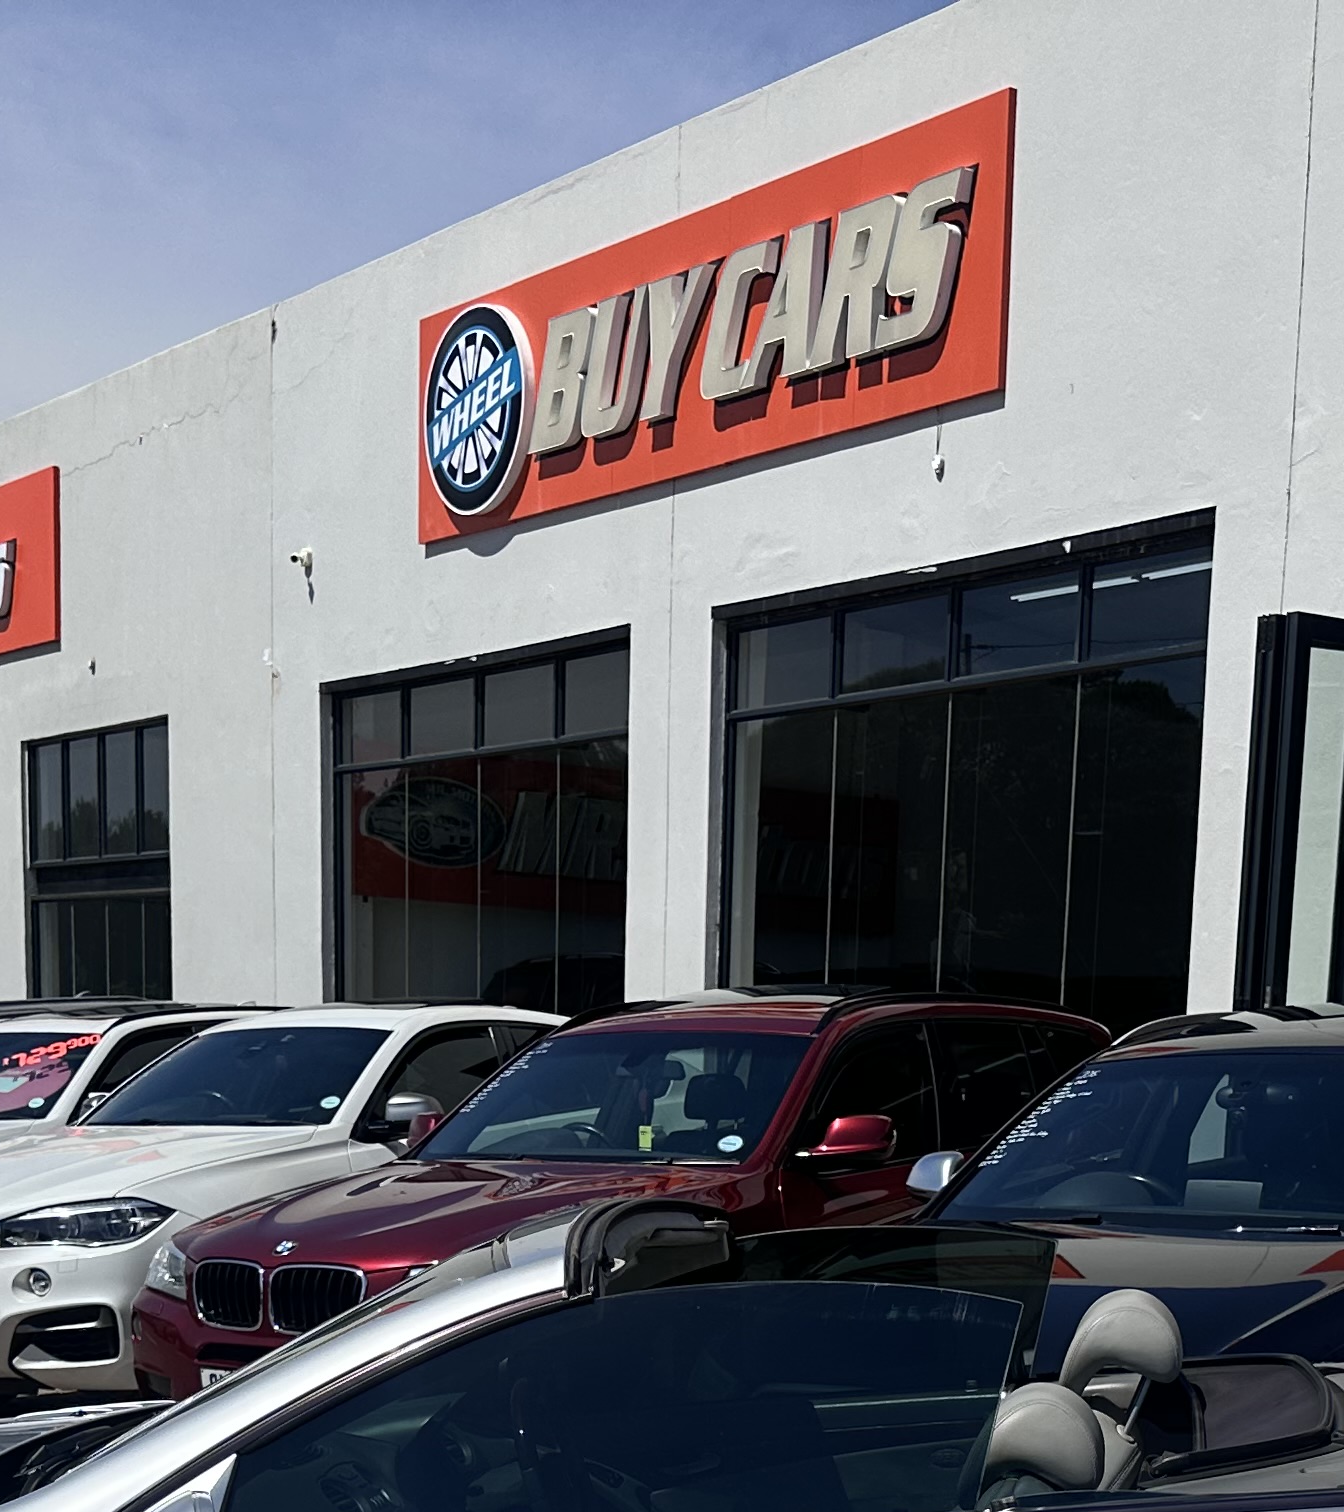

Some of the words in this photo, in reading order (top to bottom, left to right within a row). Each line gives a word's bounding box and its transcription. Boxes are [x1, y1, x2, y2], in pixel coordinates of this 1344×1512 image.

[527, 260, 719, 455] BUY
[700, 165, 977, 400] CARS
[432, 358, 516, 459] WHEEL
